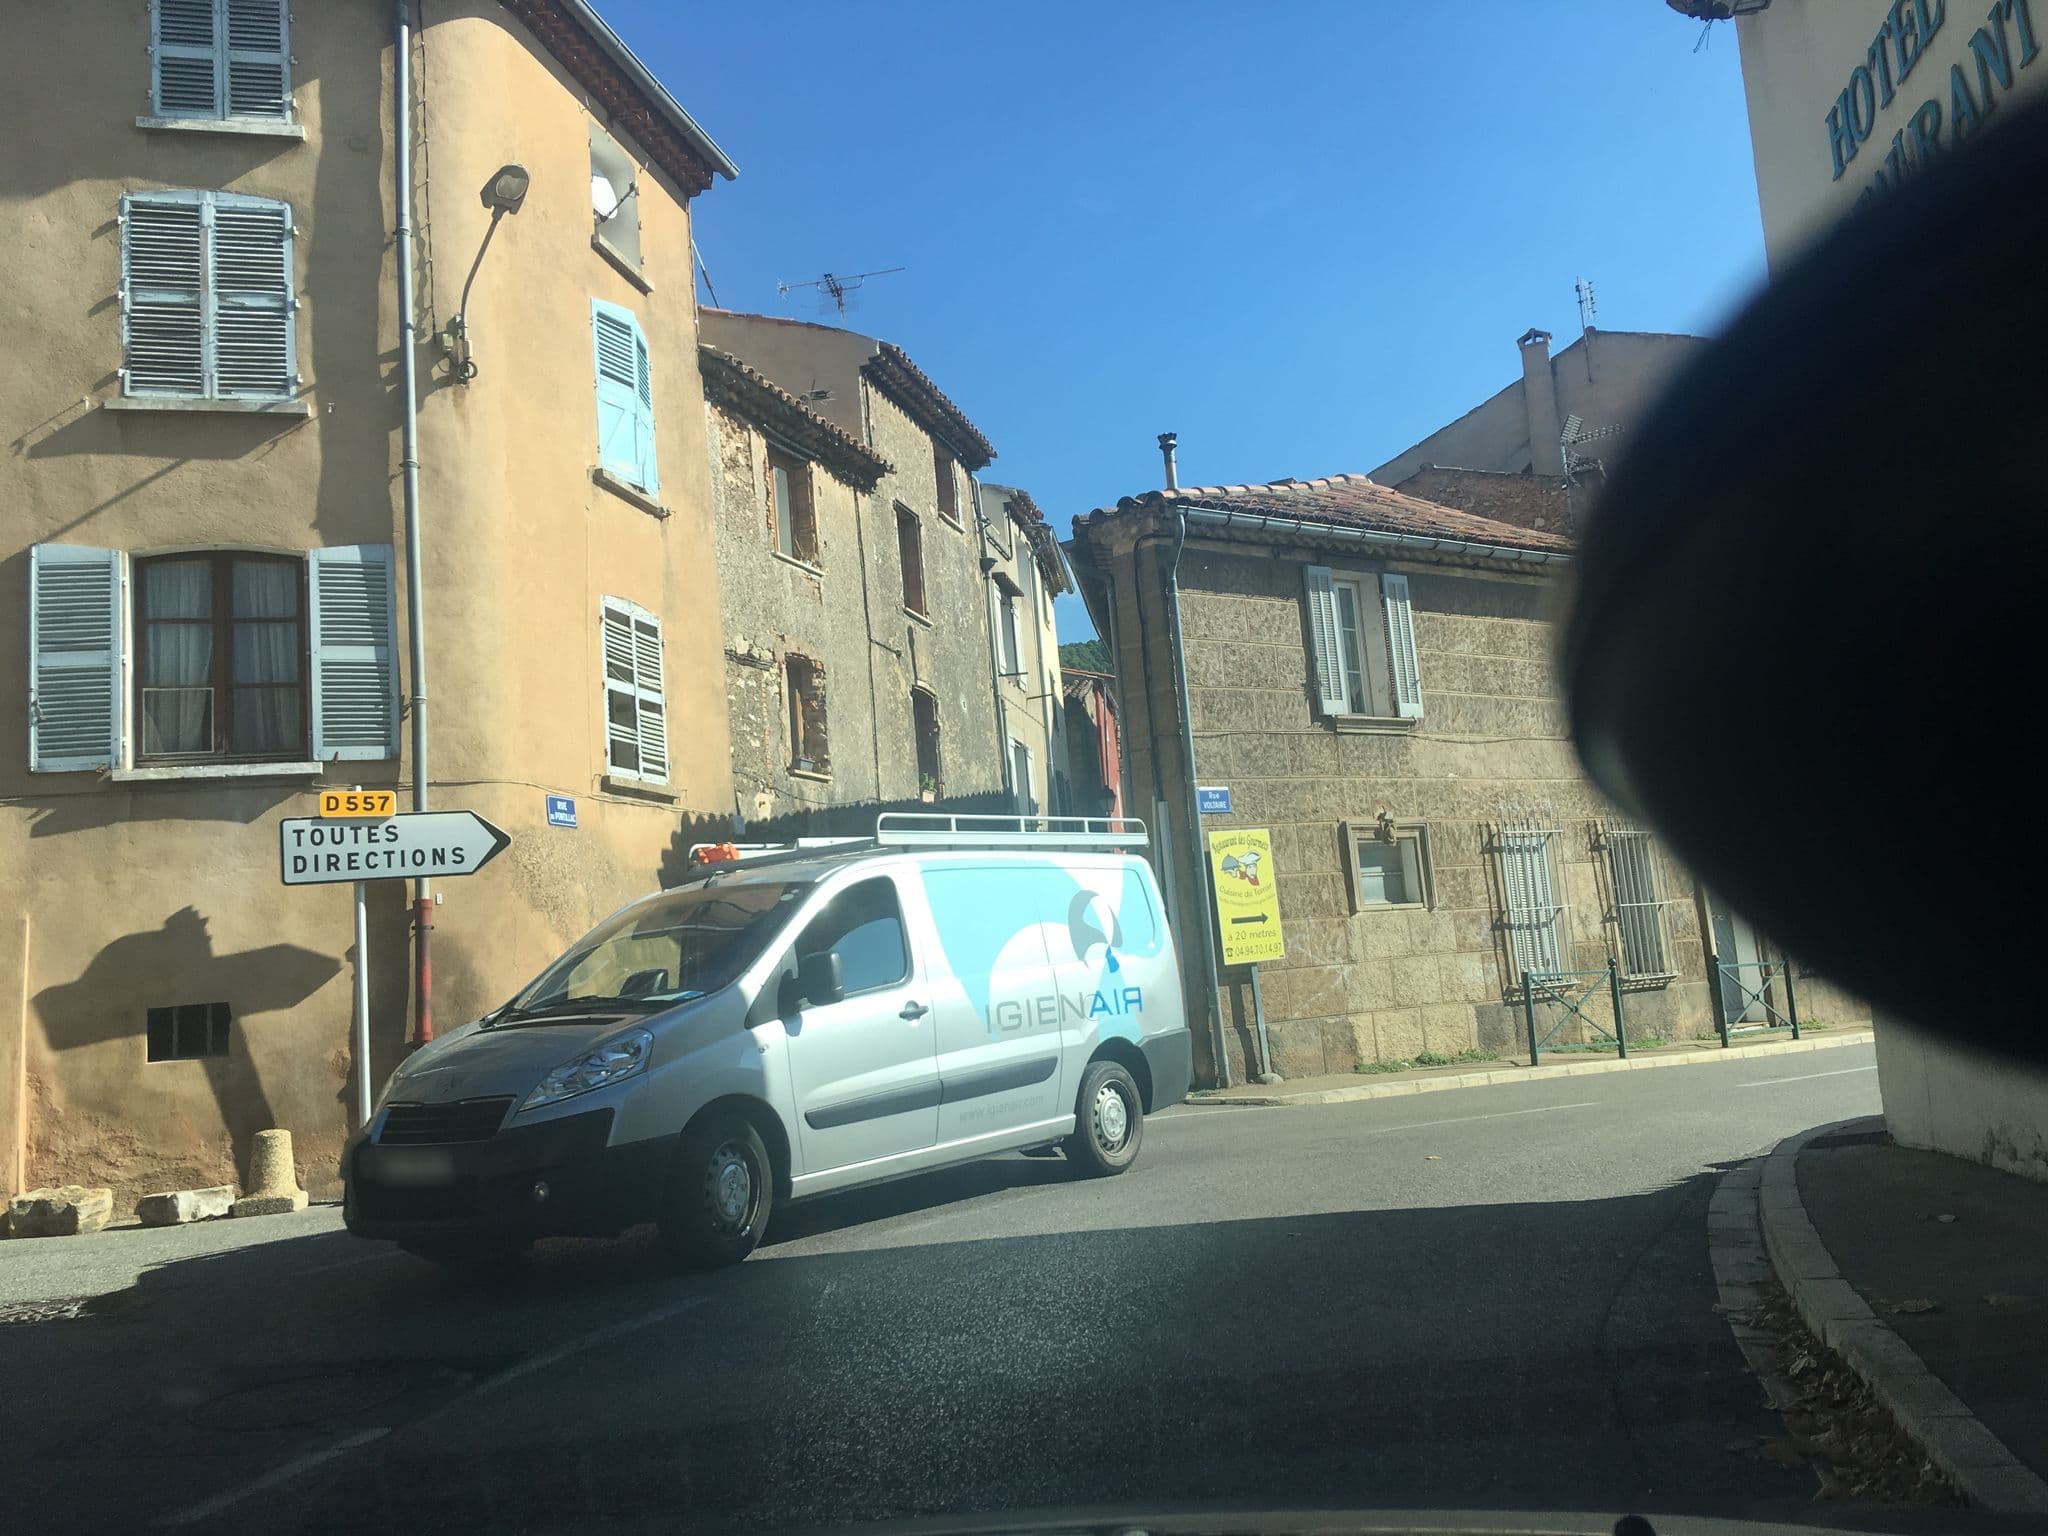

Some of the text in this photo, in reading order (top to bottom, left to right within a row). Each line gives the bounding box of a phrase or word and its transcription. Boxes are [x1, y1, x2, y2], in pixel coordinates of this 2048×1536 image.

[325, 794, 391, 811] D 557
[1202, 801, 1228, 810] VOLTAIRE
[292, 824, 400, 847] TOUTES
[293, 847, 466, 874] DIRECTIONS
[1236, 929, 1248, 940] 20
